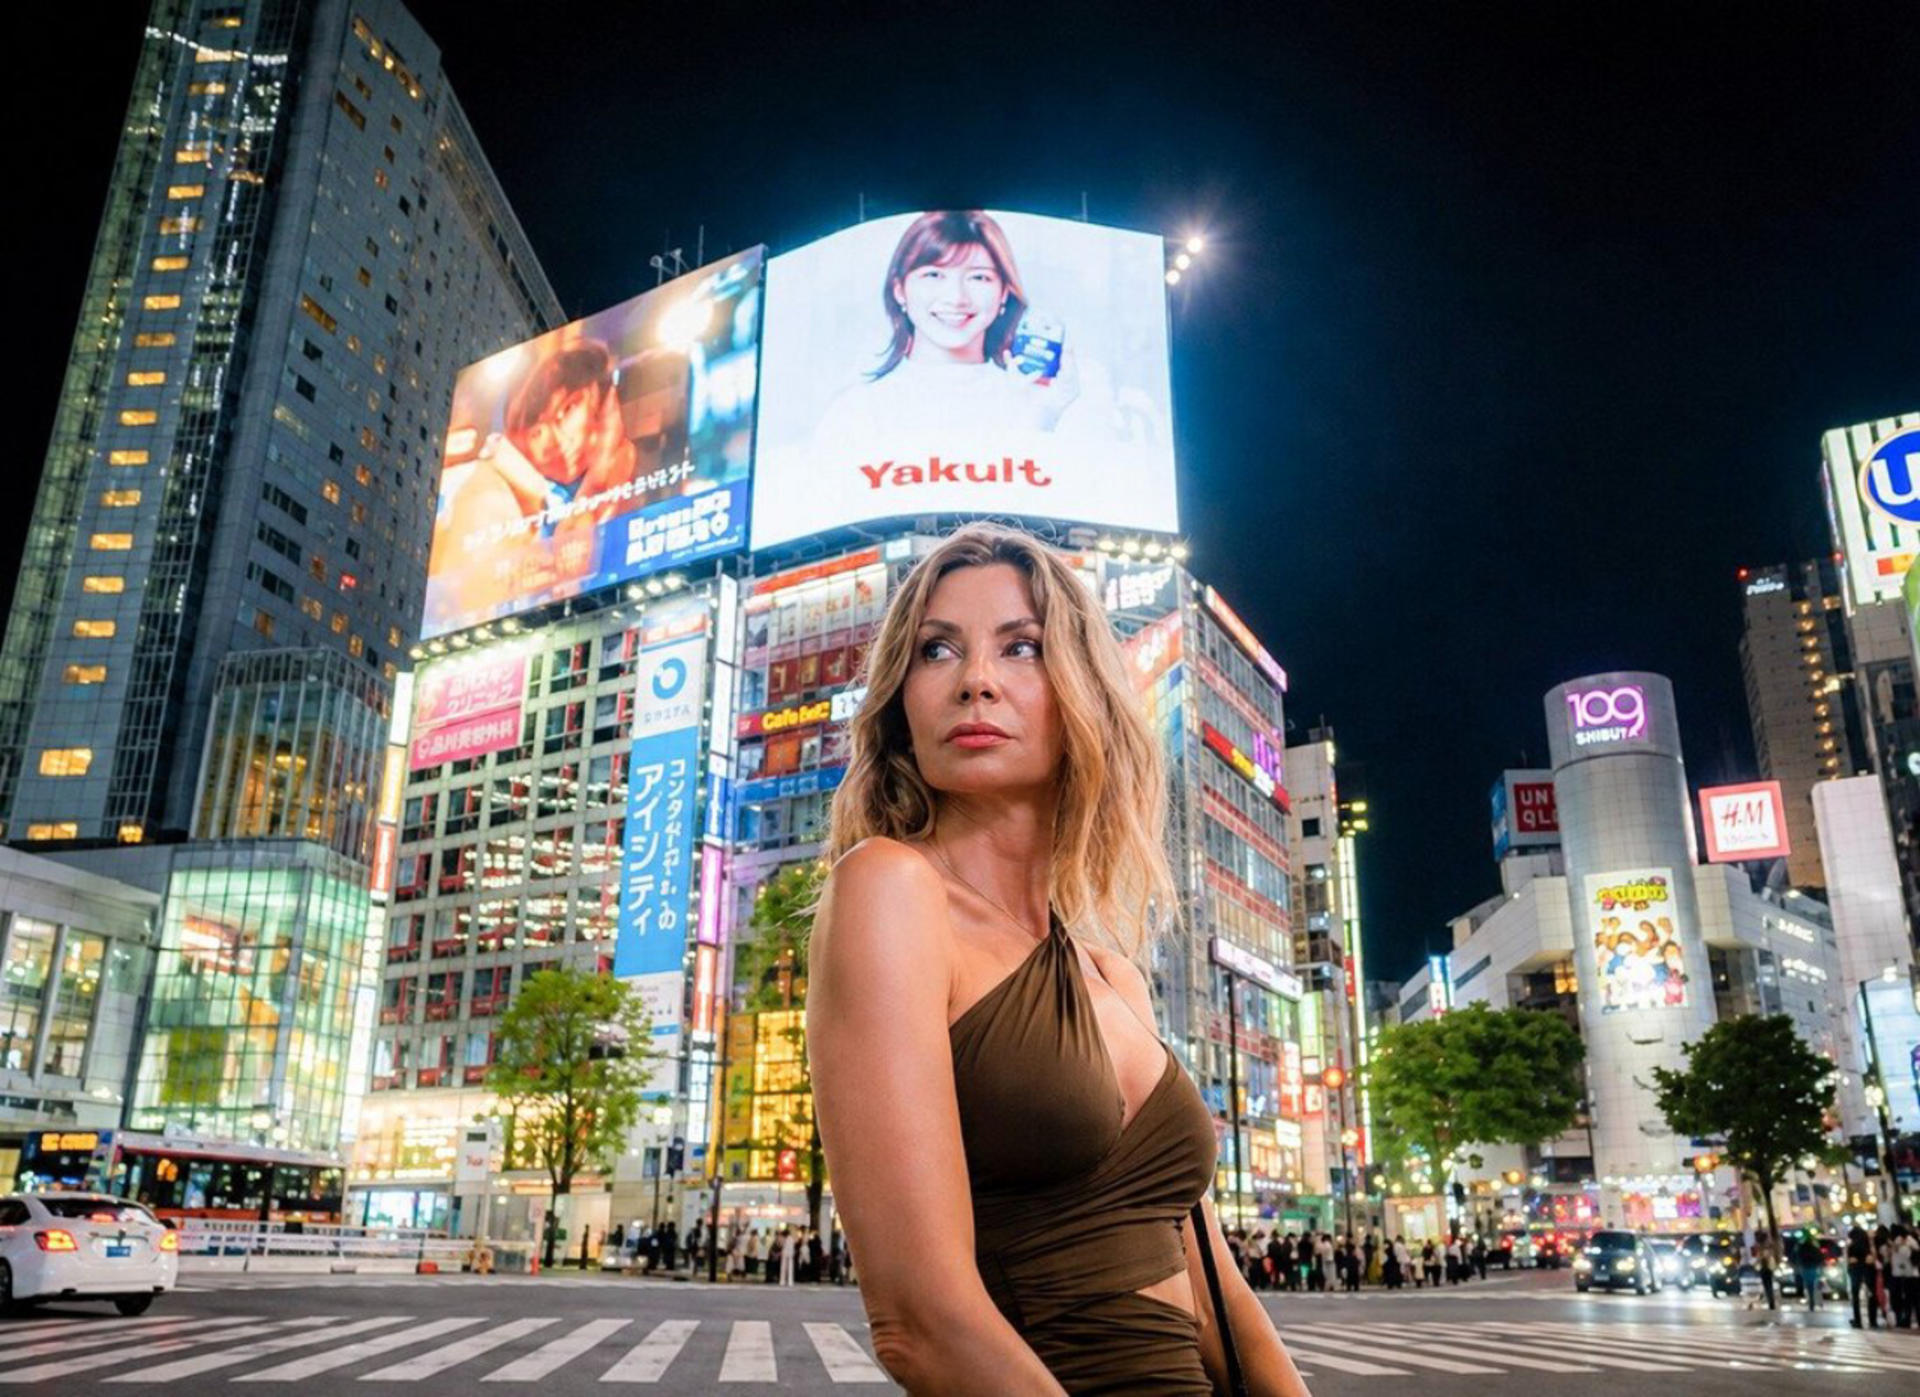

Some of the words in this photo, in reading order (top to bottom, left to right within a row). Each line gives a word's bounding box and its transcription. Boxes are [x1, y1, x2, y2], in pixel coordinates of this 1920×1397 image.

[858, 456, 1052, 489] Yakult
[1566, 687, 1645, 737] 109
[628, 763, 665, 937] アイシティ
